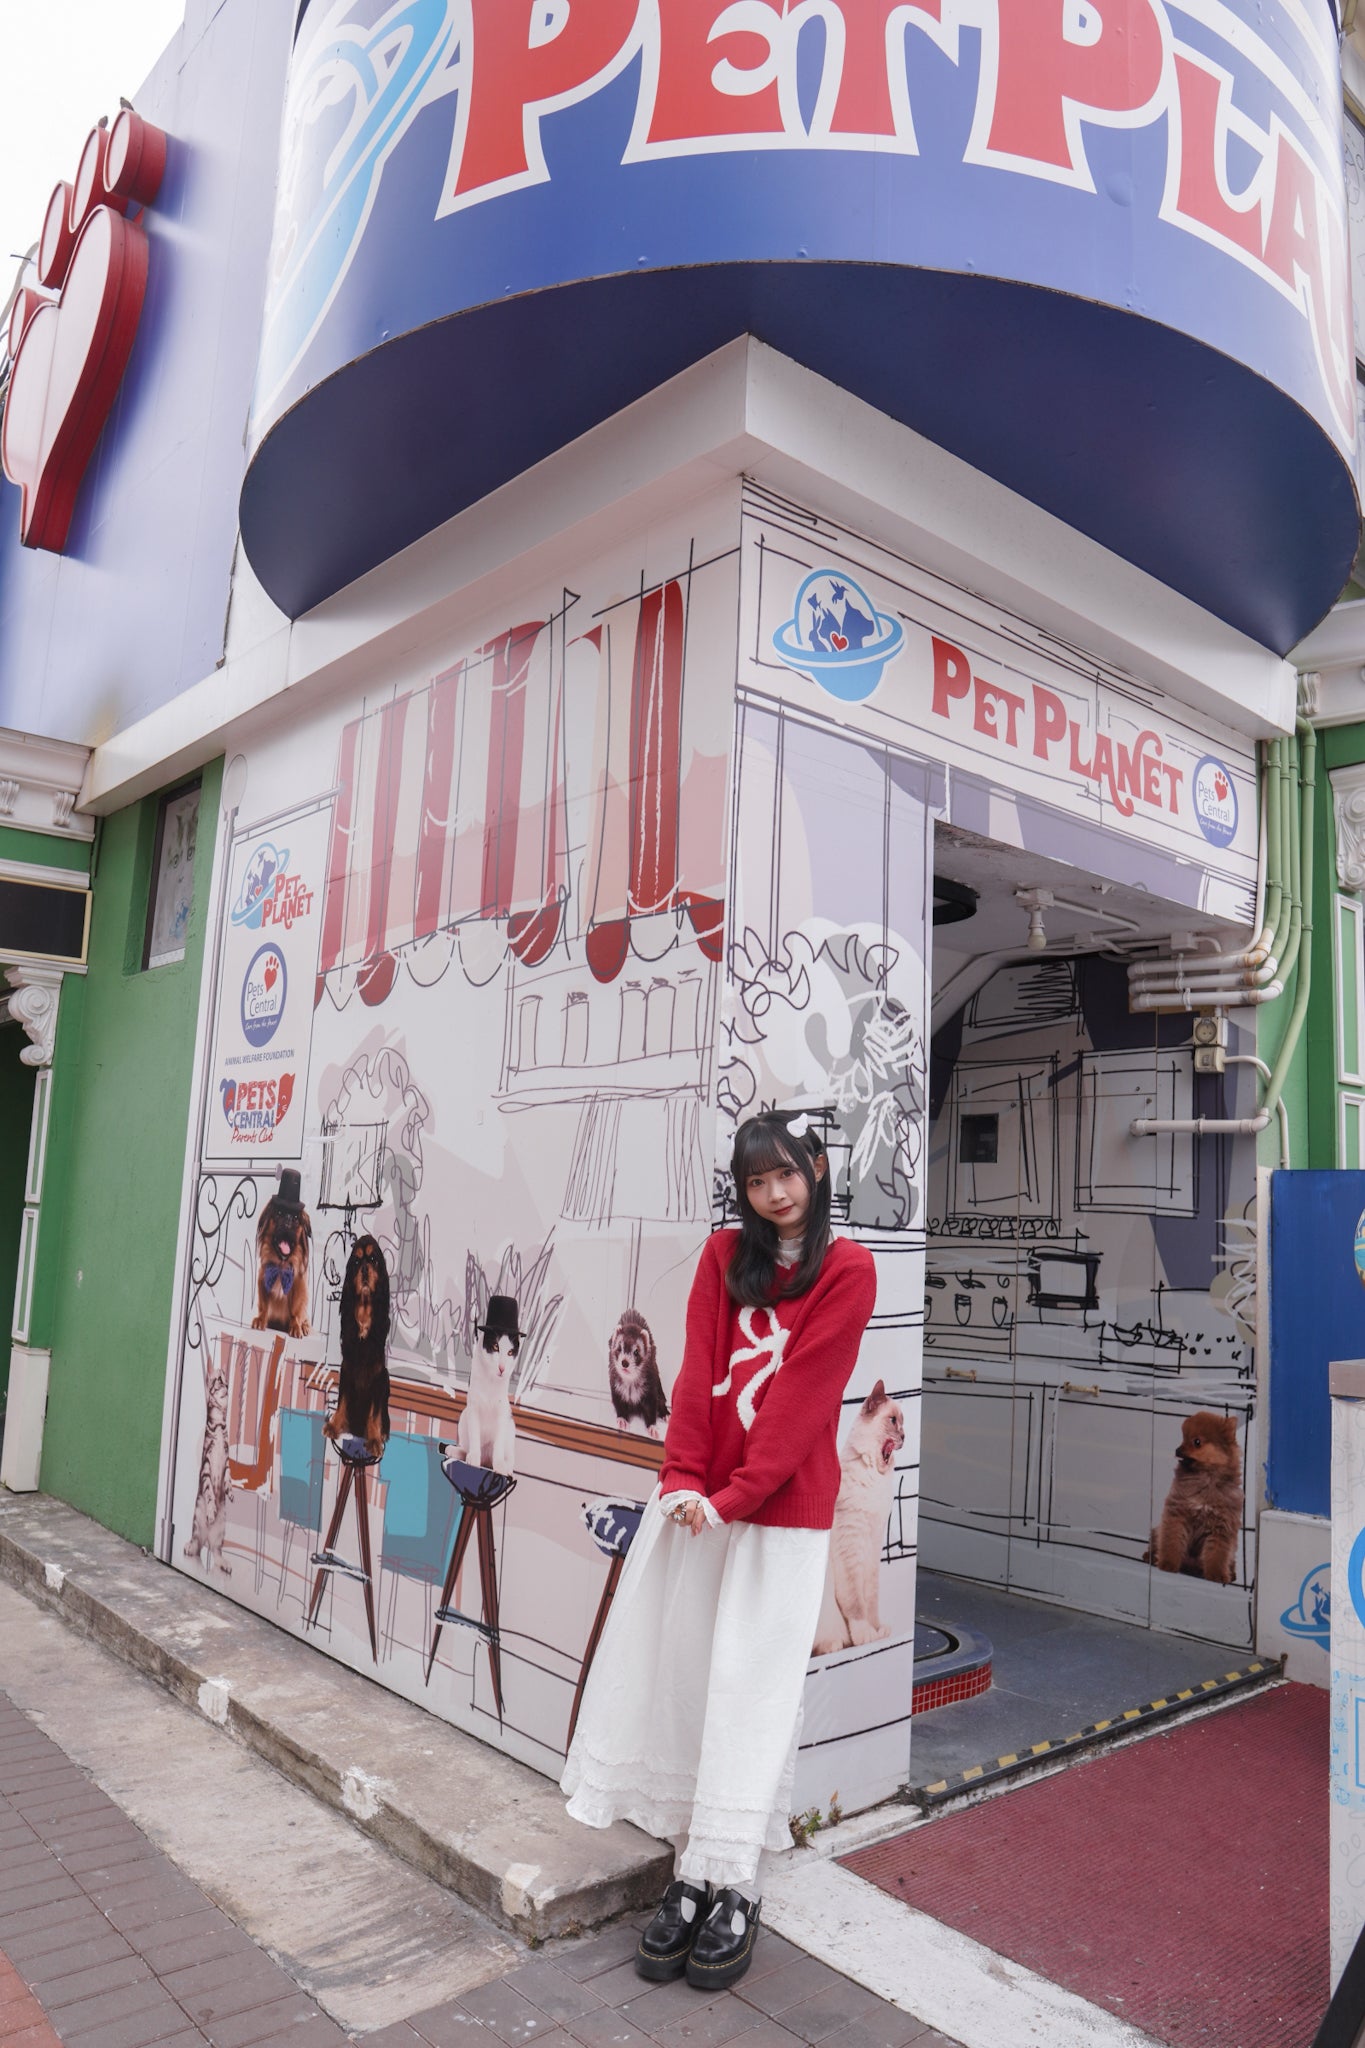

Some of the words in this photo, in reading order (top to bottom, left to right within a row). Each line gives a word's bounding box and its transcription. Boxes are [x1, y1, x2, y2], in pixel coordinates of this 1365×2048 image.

[1198, 780, 1215, 801] Pets
[1202, 799, 1230, 822] Central
[273, 873, 301, 903] PET
[261, 883, 314, 930] PLANET
[247, 981, 264, 1001] Pets
[249, 994, 277, 1017] Central
[263, 1048, 295, 1061] FOUNDATION
[236, 1079, 277, 1111] PETS
[234, 1110, 275, 1129] CENTRAL
